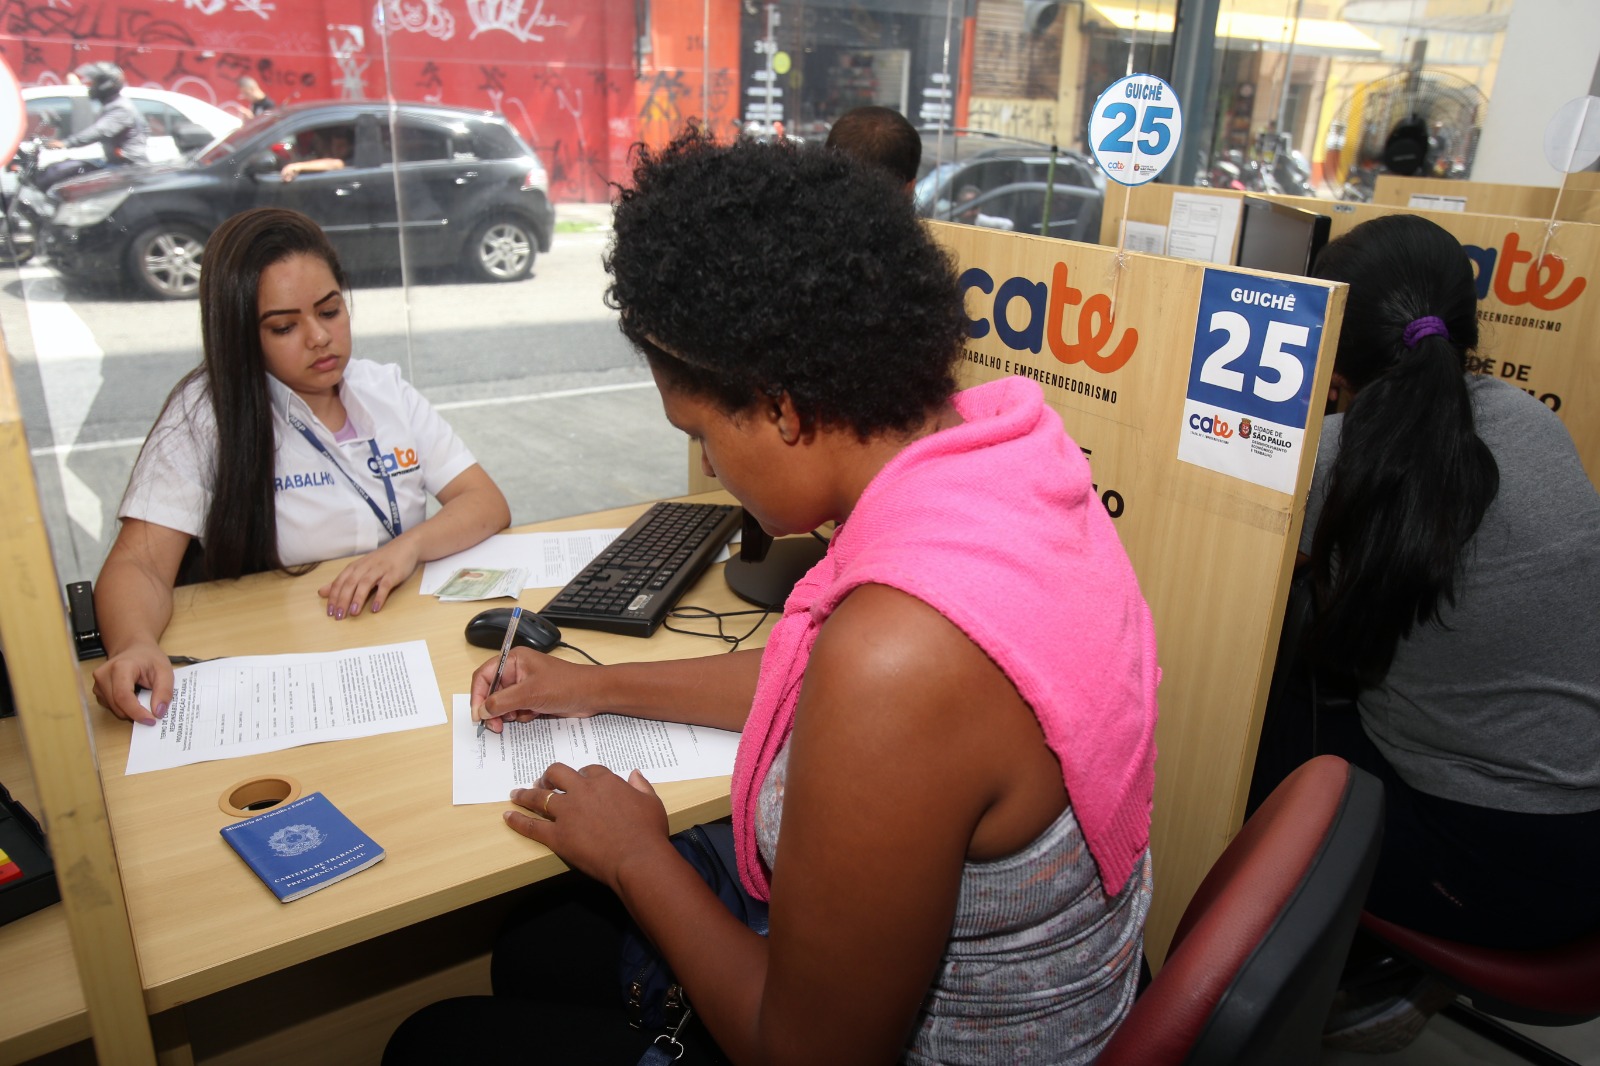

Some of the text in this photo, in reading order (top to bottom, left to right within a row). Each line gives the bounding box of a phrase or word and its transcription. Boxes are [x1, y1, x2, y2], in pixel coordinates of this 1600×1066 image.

[1125, 82, 1163, 101] GUICHÊ
[1098, 102, 1174, 156] 25
[1230, 287, 1297, 312] GUICHÊ
[959, 261, 1139, 374] cate
[1200, 310, 1310, 403] 25
[962, 348, 1117, 404] RABALHO E EMPREENDEDORISMO
[1500, 361, 1532, 382] DE
[1189, 413, 1234, 439] cate
[1253, 425, 1283, 439] CIDADE DE
[1252, 431, 1292, 448] SÃO PAULO
[274, 471, 335, 491] RABALHO
[390, 500, 400, 524] PMSP
[178, 698, 186, 722] OPERAÇÃO
[225, 820, 255, 831] Ministério
[263, 808, 288, 819] Trabalho
[291, 796, 315, 809] Emprego
[274, 866, 314, 883] CARTEIRA
[325, 843, 365, 864] TRABALHO
[286, 852, 366, 888] PREVIDÊNCIA SOCIAL
